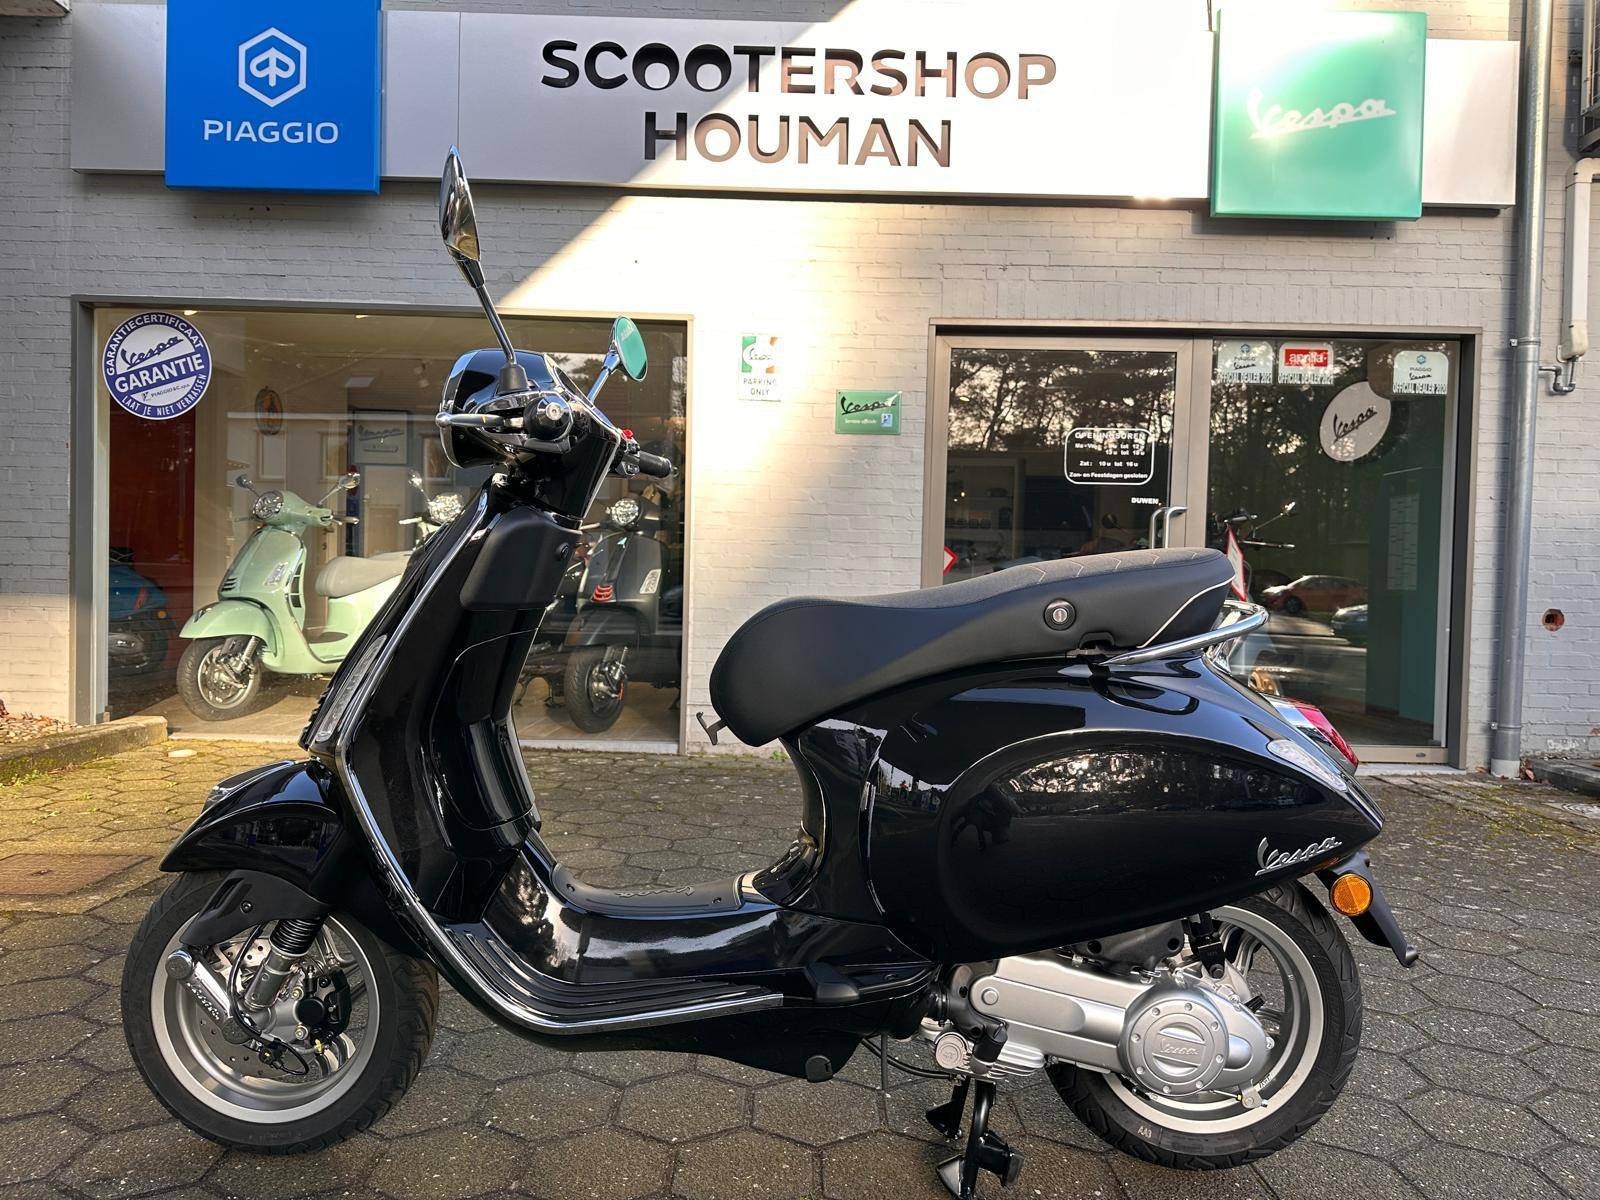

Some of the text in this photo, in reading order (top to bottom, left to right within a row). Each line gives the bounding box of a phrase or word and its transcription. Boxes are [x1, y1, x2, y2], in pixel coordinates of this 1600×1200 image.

[540, 39, 1057, 100] SCOOTERSHOP
[203, 119, 339, 144] PIAGGIO
[1247, 88, 1397, 139] Vespa
[643, 111, 952, 168] HOUMAN
[106, 314, 204, 376] GARANTIECERTIFICAAT
[120, 336, 184, 370] Vespa
[114, 353, 205, 393] GARANTIE
[122, 374, 207, 416] LAAT JE NIET VERRASSEN
[1333, 406, 1378, 443] Vespa
[1255, 836, 1342, 876] Vespa
